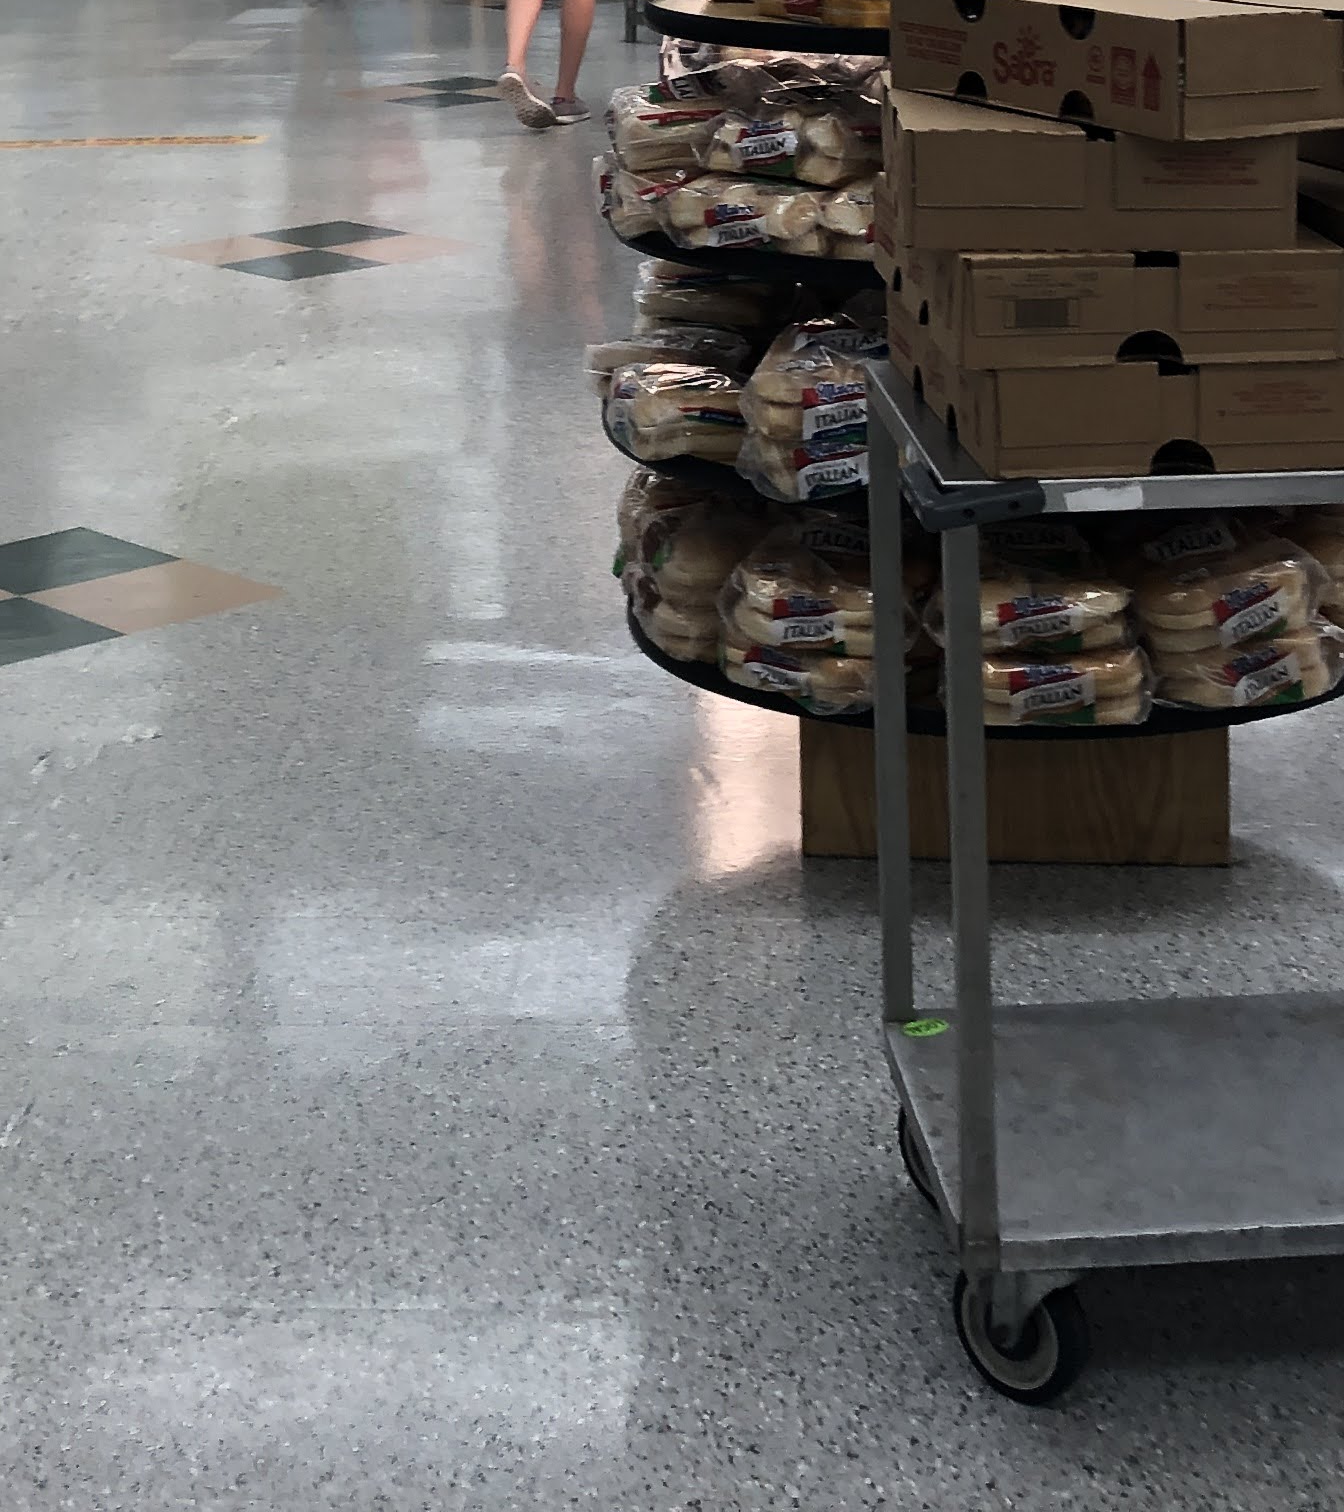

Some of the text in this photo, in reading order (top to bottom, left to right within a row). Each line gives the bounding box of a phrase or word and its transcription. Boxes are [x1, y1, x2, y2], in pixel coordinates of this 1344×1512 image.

[993, 40, 1057, 87] Sabra
[739, 138, 786, 159] ITALIAN
[805, 464, 860, 487] ITALIAN
[783, 620, 835, 639] ITALIAN
[1011, 614, 1071, 636] ITALIAN
[1231, 600, 1280, 639] ITALIAN
[1022, 683, 1083, 709] ITALIAN
